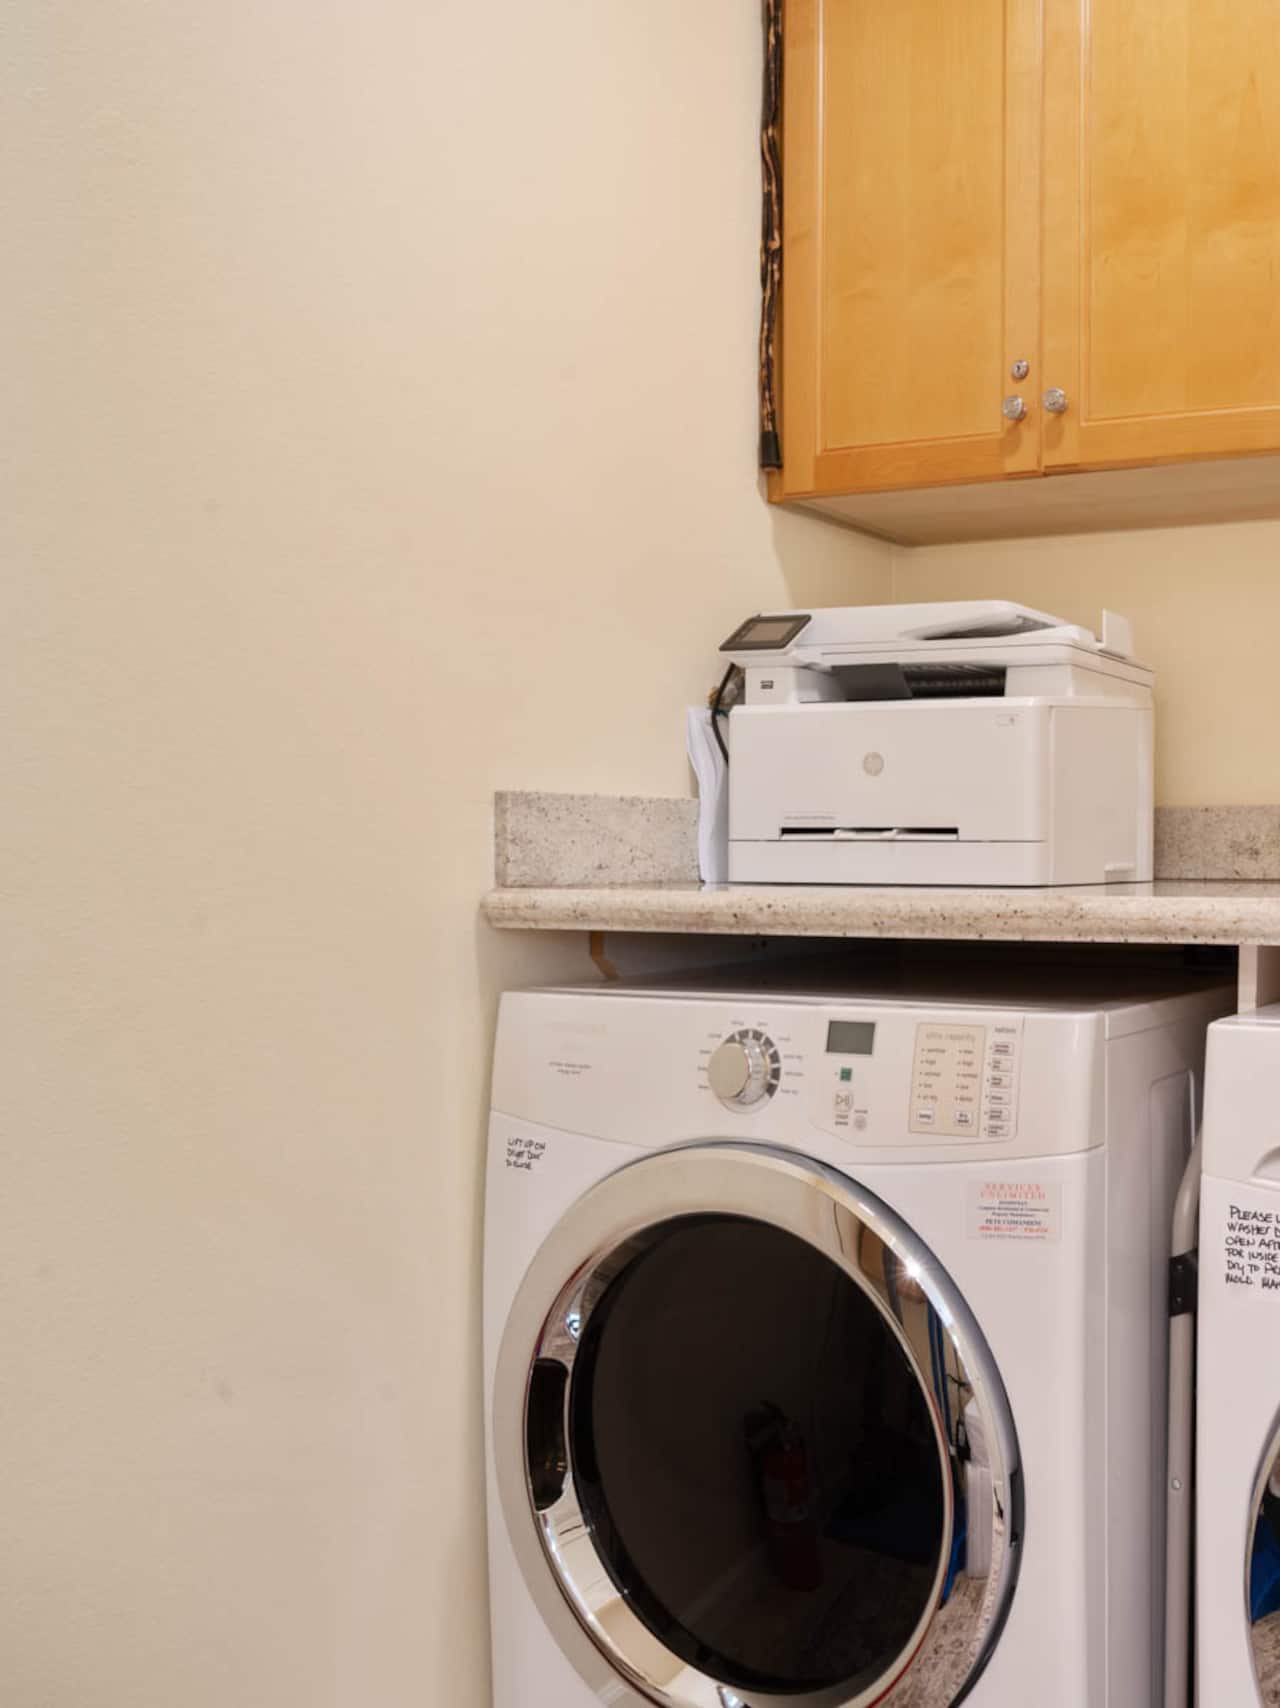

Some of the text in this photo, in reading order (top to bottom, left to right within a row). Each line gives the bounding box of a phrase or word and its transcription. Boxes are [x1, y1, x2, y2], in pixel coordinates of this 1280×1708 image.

[984, 1183, 1040, 1191] SERVICES
[980, 1191, 1046, 1200] UNLIMITED
[1230, 1205, 1273, 1223] PLEASE
[1225, 1236, 1256, 1247] OPEN
[1248, 1251, 1279, 1263] INSIDE
[1248, 1263, 1260, 1274] TO
